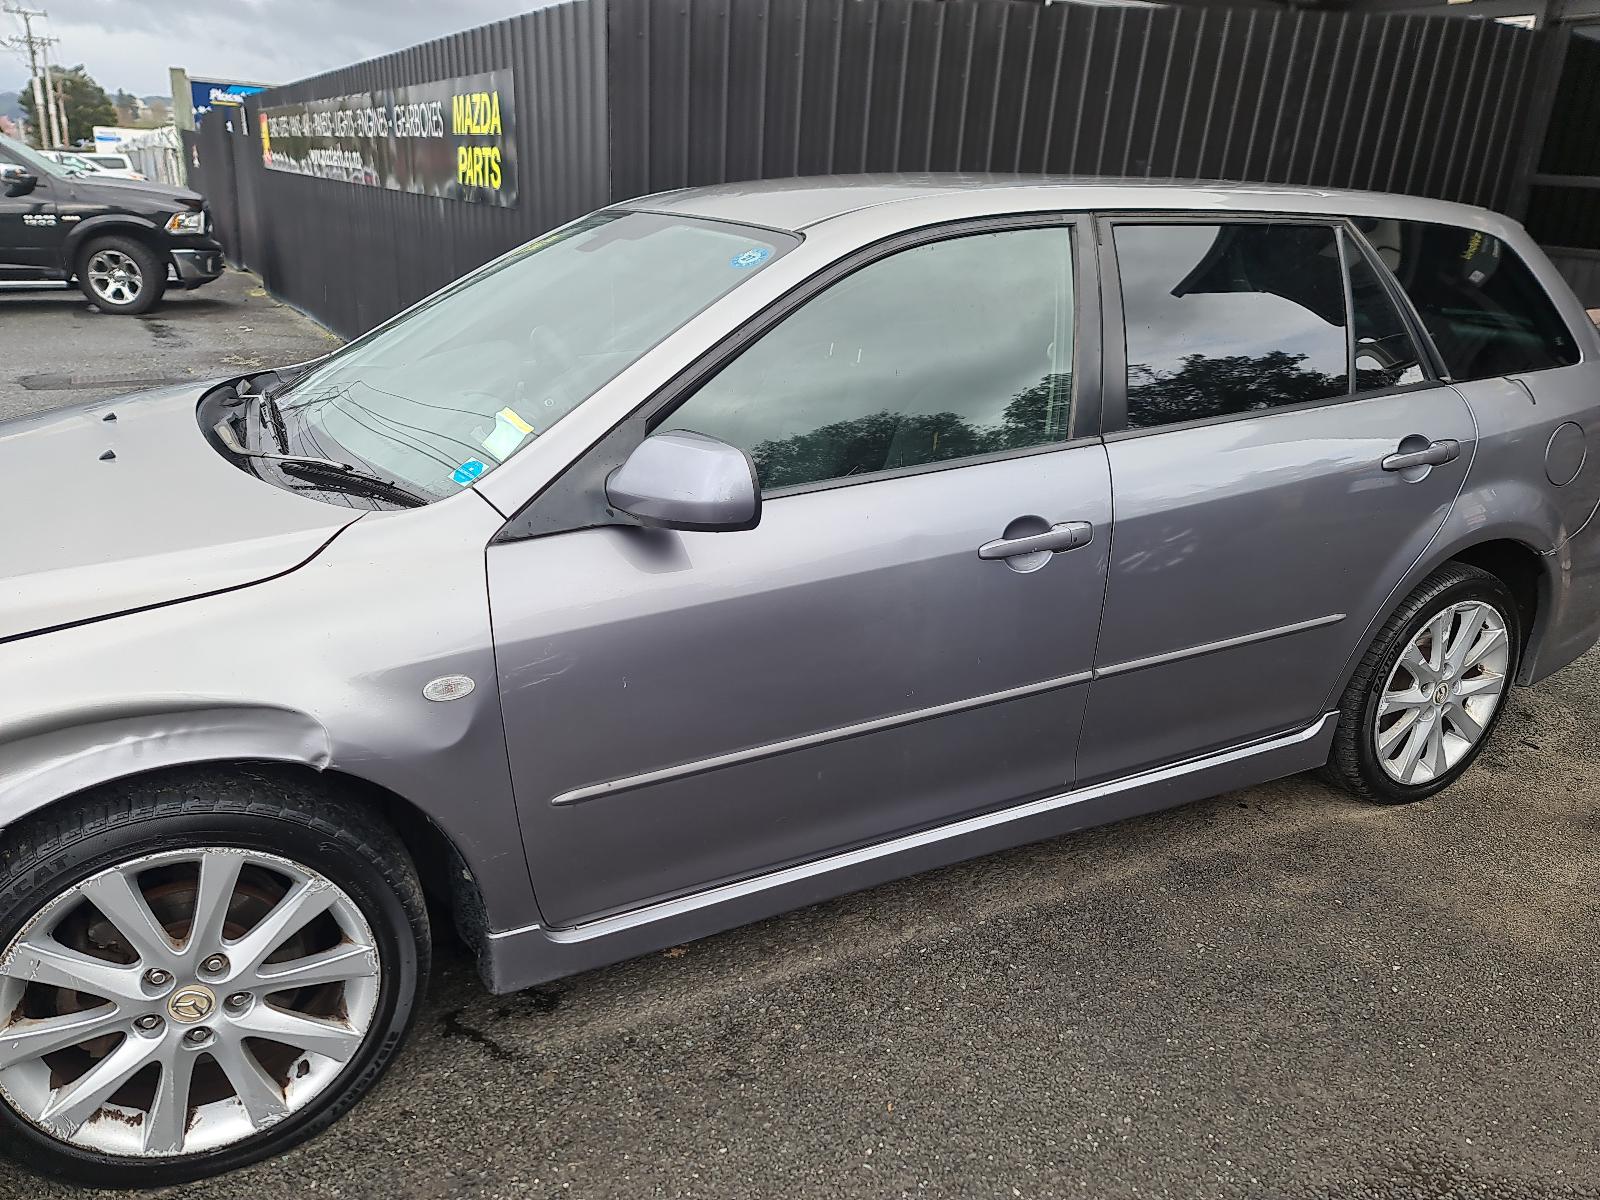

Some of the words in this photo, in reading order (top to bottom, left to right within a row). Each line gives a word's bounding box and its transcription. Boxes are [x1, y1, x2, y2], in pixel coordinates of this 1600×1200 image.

[356, 105, 388, 138] ENGINES
[394, 101, 443, 138] GEARBOXES
[452, 90, 502, 136] MAZDA
[457, 145, 502, 190] PARTS
